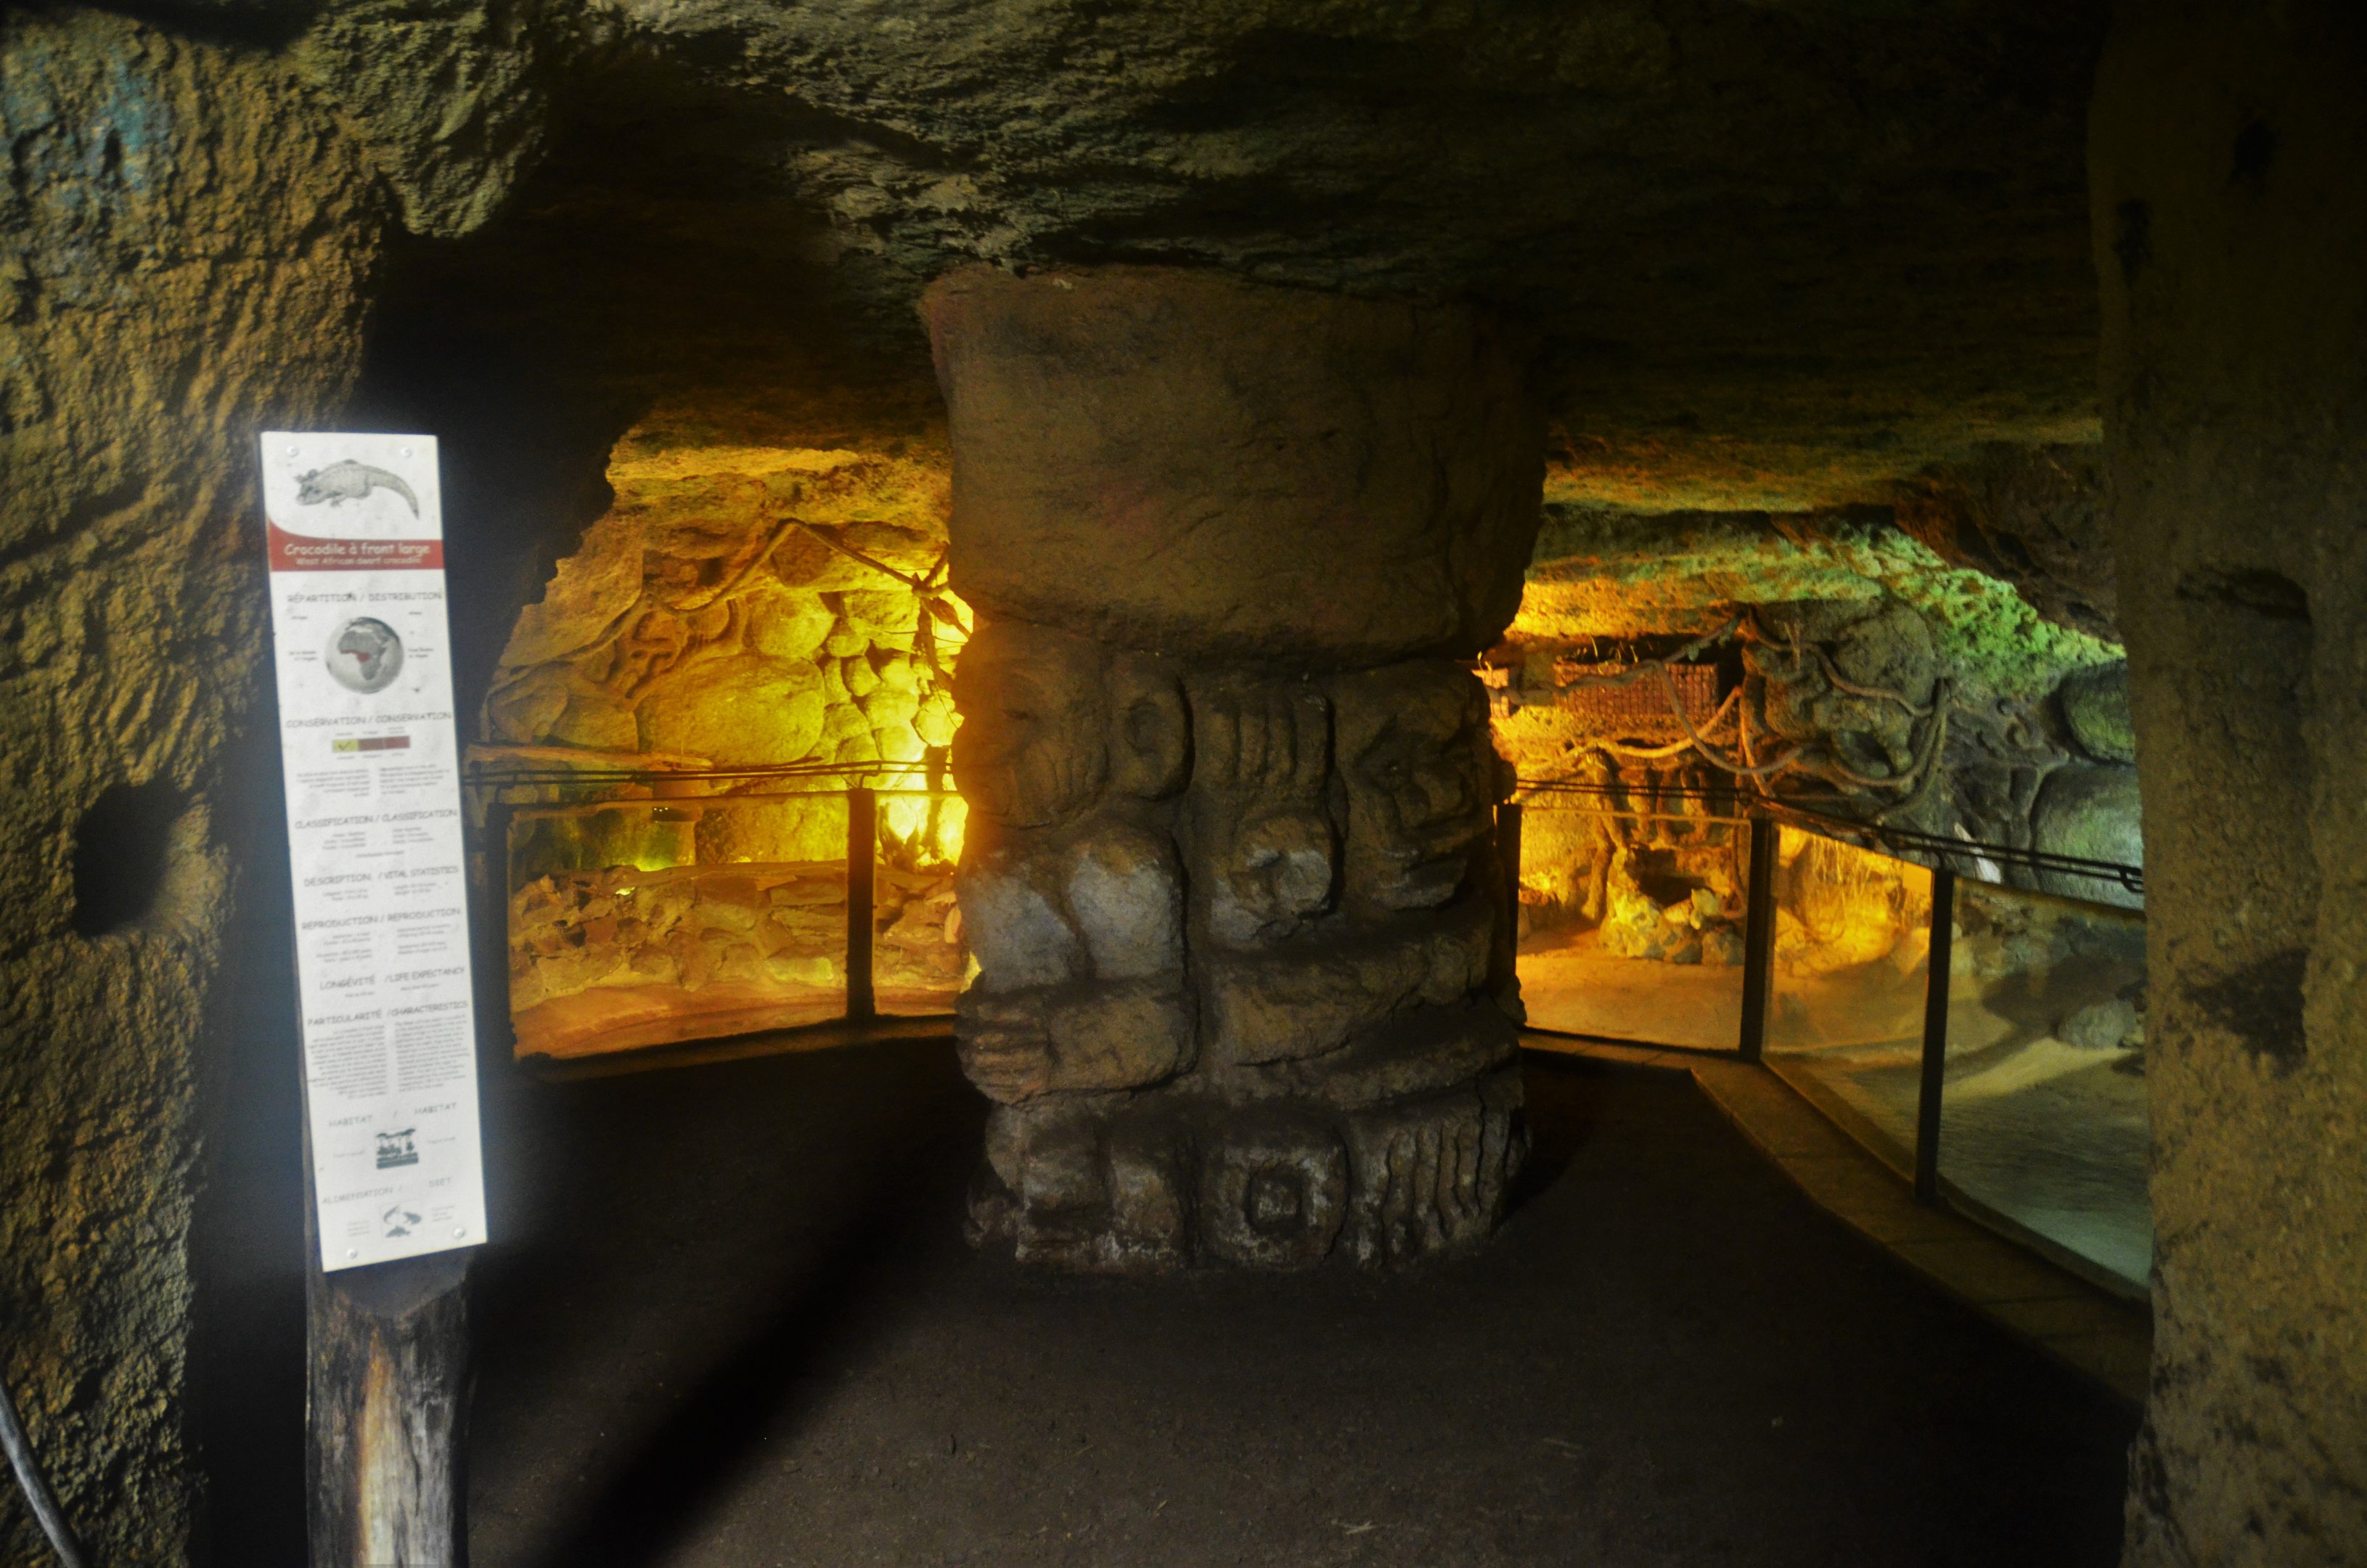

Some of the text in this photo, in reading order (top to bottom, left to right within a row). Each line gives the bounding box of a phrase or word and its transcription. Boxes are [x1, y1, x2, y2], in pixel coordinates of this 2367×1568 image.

[284, 542, 430, 558] Crocodile à front large
[287, 592, 356, 603] RÉPARTITION
[369, 592, 442, 602] DISTRIBUTION
[286, 716, 366, 728] CONSERVATION
[376, 711, 451, 724] CONSERVATION
[295, 816, 373, 829] CLASSIFICATION
[383, 809, 457, 821] CLASSIFICATION
[303, 873, 372, 886] DESCRIPTION
[384, 870, 407, 879] VITAL
[410, 866, 459, 876] STATISTICS
[302, 915, 377, 930] REPRODUCTION
[388, 908, 461, 921] REPRODUCTION
[320, 974, 375, 990] LONGÉVITÉ
[390, 972, 409, 982] LIFE
[412, 967, 465, 979] EXPECTANCY
[307, 1009, 382, 1026] PARTICULARITÉ
[392, 1001, 467, 1017] CHARACTERISTICS
[329, 1114, 373, 1126] HABITAT
[414, 1103, 457, 1114] HABITAT
[322, 1186, 393, 1204] ALIMENTATION
[429, 1177, 451, 1188] DIET
